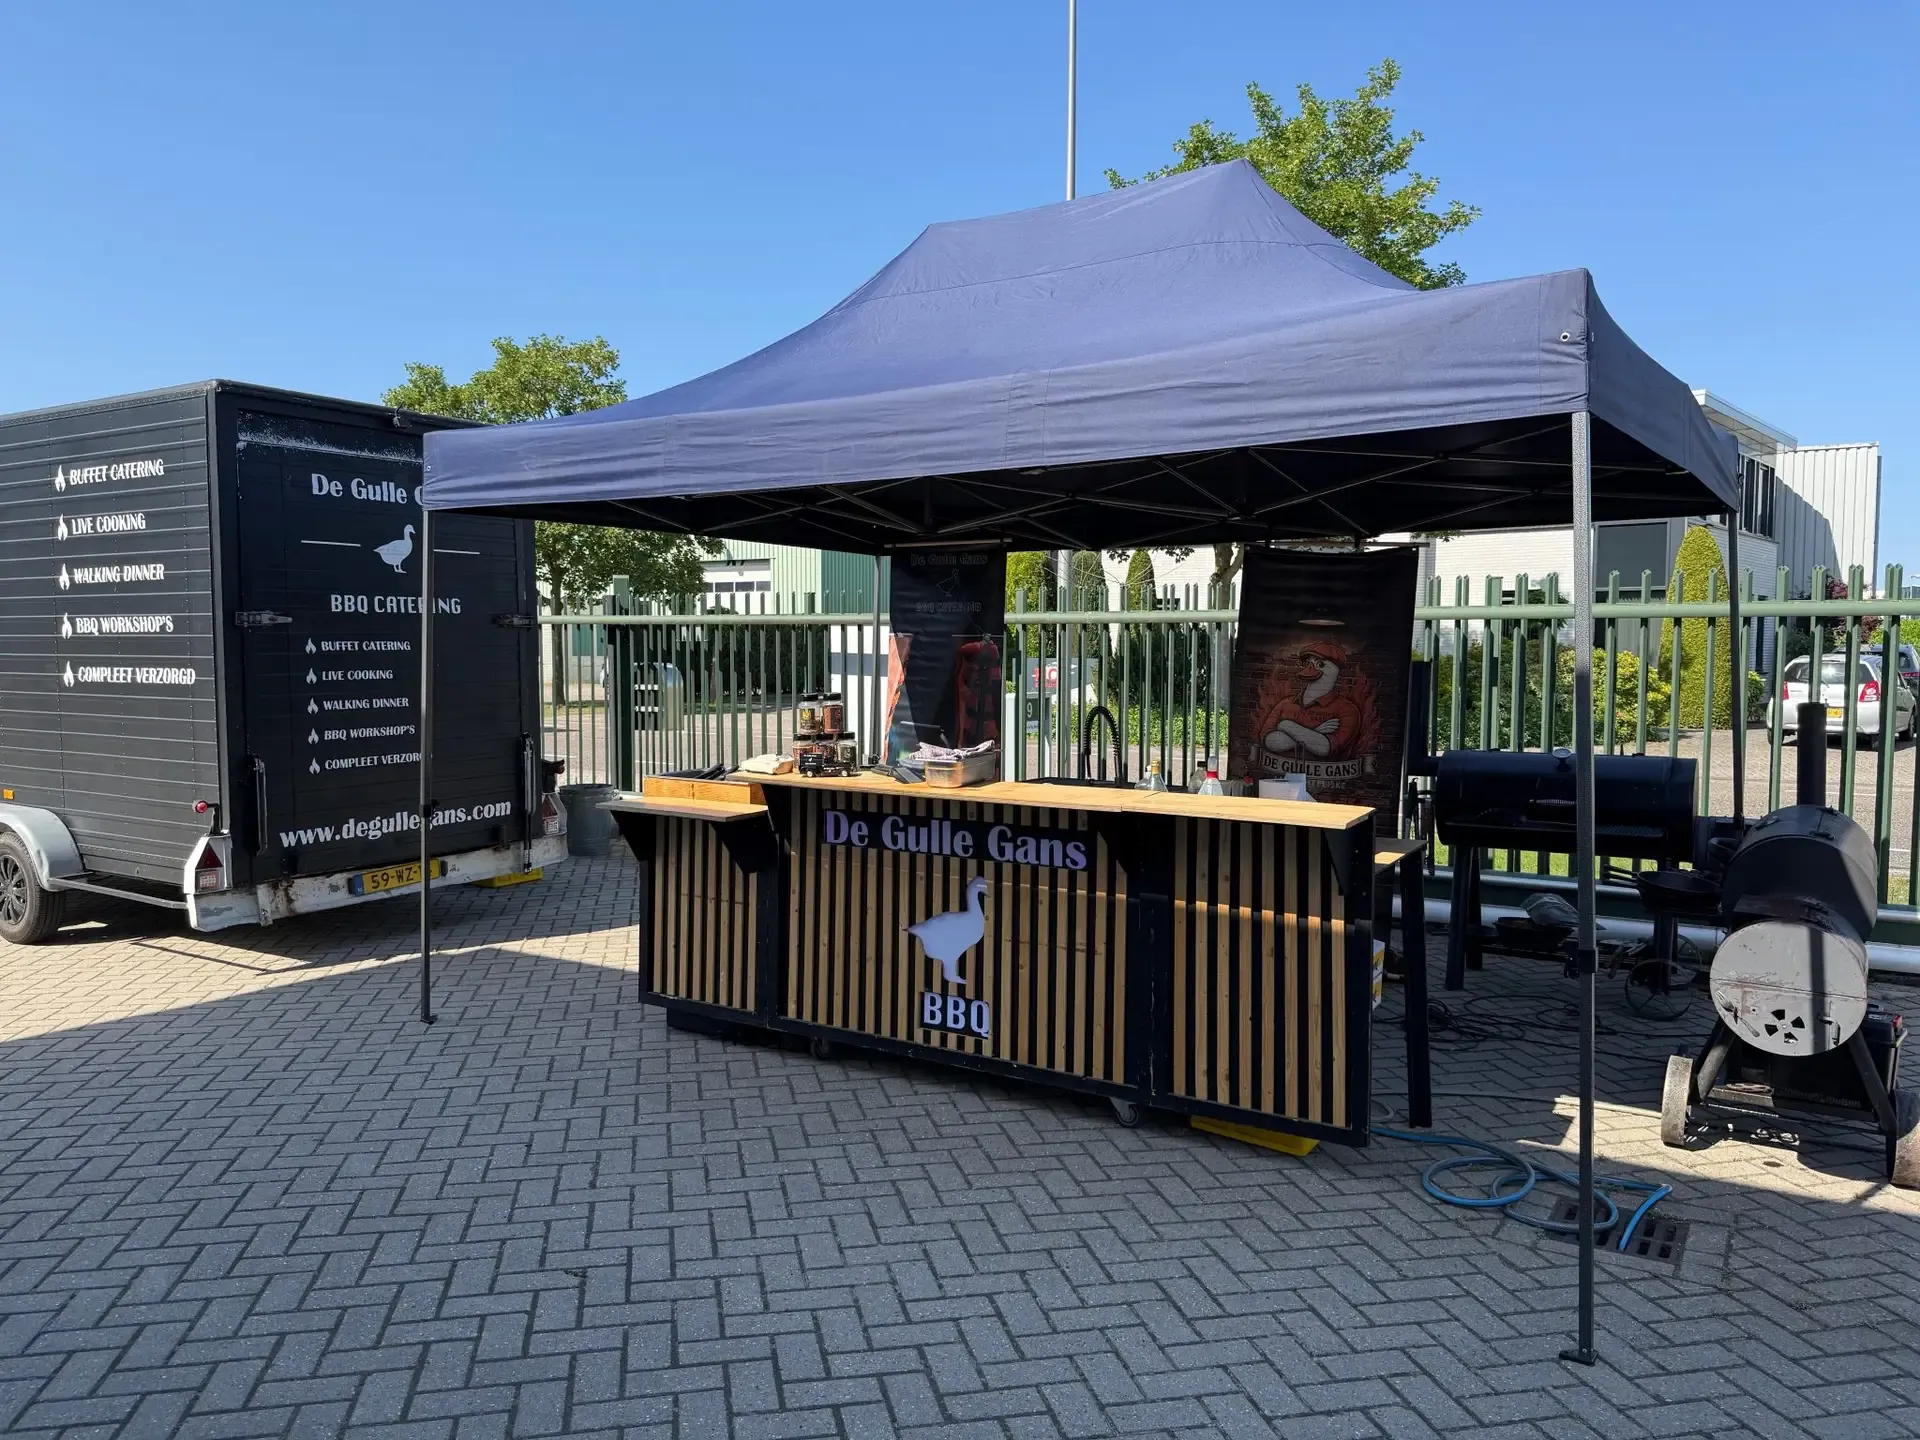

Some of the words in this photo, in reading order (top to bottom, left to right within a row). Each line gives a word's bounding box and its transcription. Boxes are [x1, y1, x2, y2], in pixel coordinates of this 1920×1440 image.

[70, 464, 107, 486] BUFFET
[110, 459, 164, 480] CATERING
[312, 473, 343, 497] De
[351, 478, 407, 504] Gulle
[72, 518, 94, 534] LIVE
[96, 513, 146, 532] COOKING
[73, 566, 121, 584] WALKING
[123, 563, 165, 583] DINNER
[331, 595, 369, 613] BBQ
[75, 615, 99, 635] BBQ
[100, 615, 174, 634] WORKSHOP'S
[320, 640, 360, 651] BUFFET
[362, 639, 412, 651] CATERING
[77, 666, 133, 684] COMPLEET
[135, 667, 196, 685] VERZORGD
[321, 669, 345, 681] LIVE
[347, 669, 394, 681] COOKING
[323, 699, 370, 710] WALKING
[373, 698, 409, 709] DINNER
[323, 729, 348, 742] BBQ
[349, 724, 416, 739] WORKSHOP'S
[325, 756, 379, 770] COMPLEET
[382, 752, 433, 765] VERZOR
[1264, 757, 1279, 770] DE
[1281, 760, 1322, 777] GULLE
[1325, 763, 1358, 777] GANS
[280, 801, 511, 847] www.degulleans.com
[825, 810, 869, 847] De
[881, 815, 974, 858] Gulle
[987, 825, 1088, 871] Gans
[371, 865, 433, 889] 59-WZ-
[923, 991, 990, 1037] BBQ
